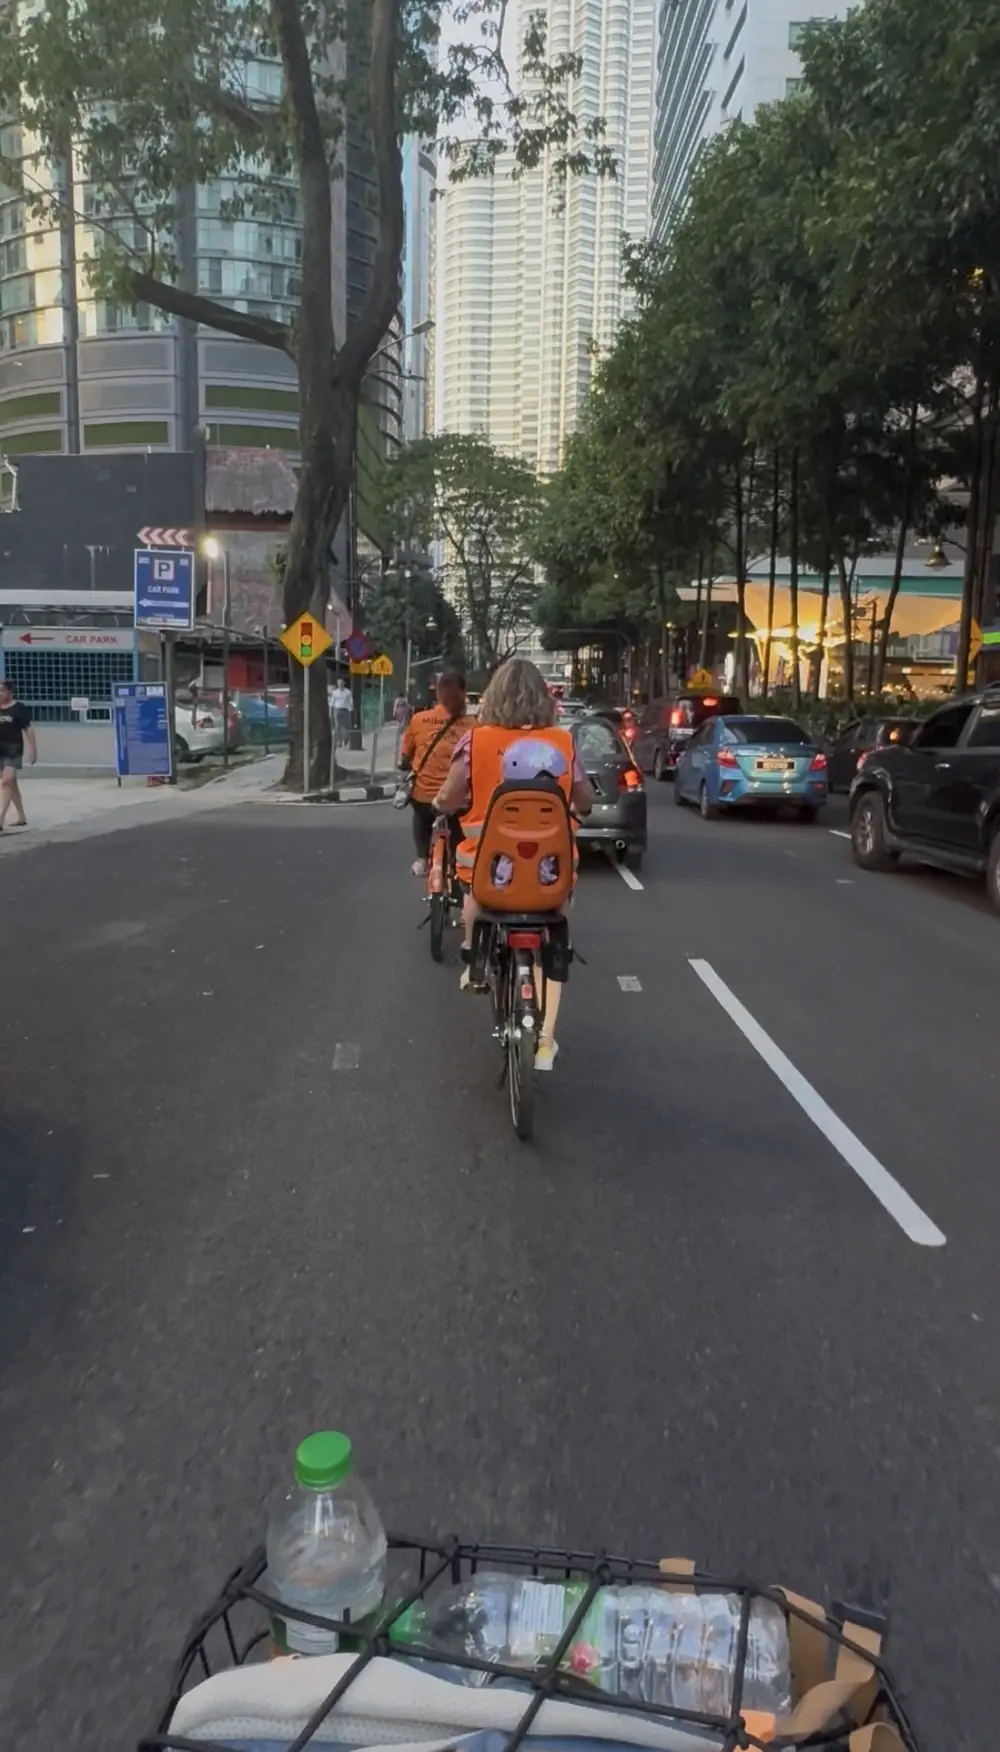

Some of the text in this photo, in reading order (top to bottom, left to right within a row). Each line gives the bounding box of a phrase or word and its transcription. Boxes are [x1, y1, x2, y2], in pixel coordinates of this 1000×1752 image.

[158, 562, 171, 577] P
[64, 635, 118, 645] CAR PARK
